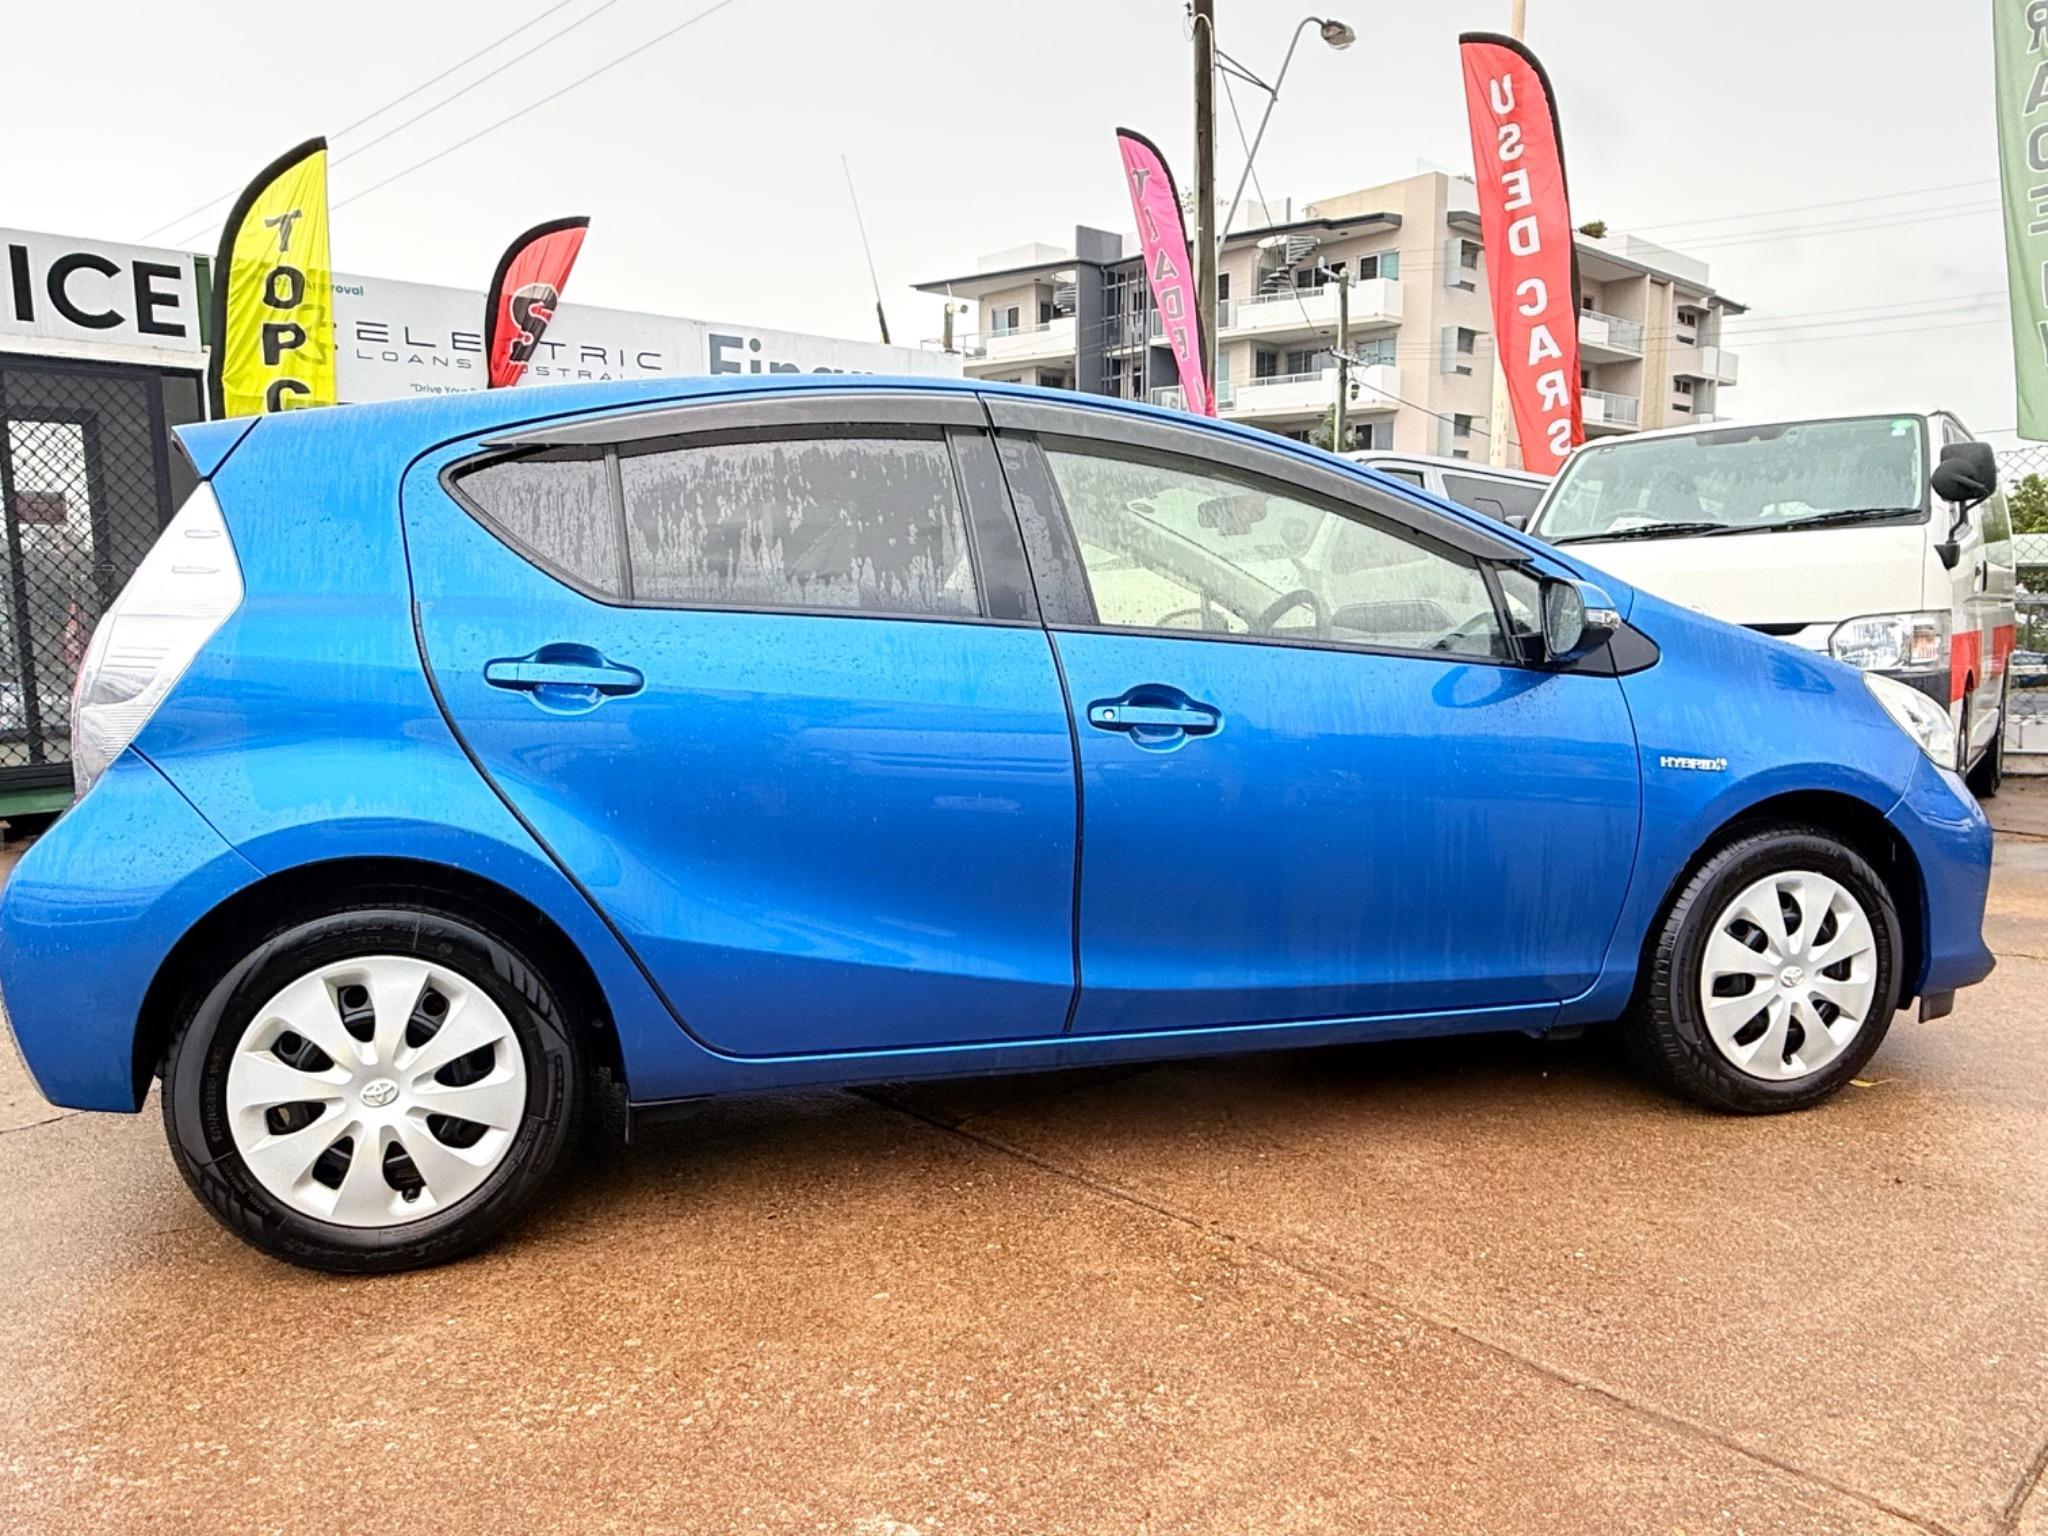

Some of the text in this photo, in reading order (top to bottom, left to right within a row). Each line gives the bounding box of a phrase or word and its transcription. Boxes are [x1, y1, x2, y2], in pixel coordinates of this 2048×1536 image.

[9, 244, 186, 337] ICE
[356, 320, 662, 371] ELETRIC
[356, 348, 472, 369] LOANS
[1660, 756, 1717, 770] HYBRID
